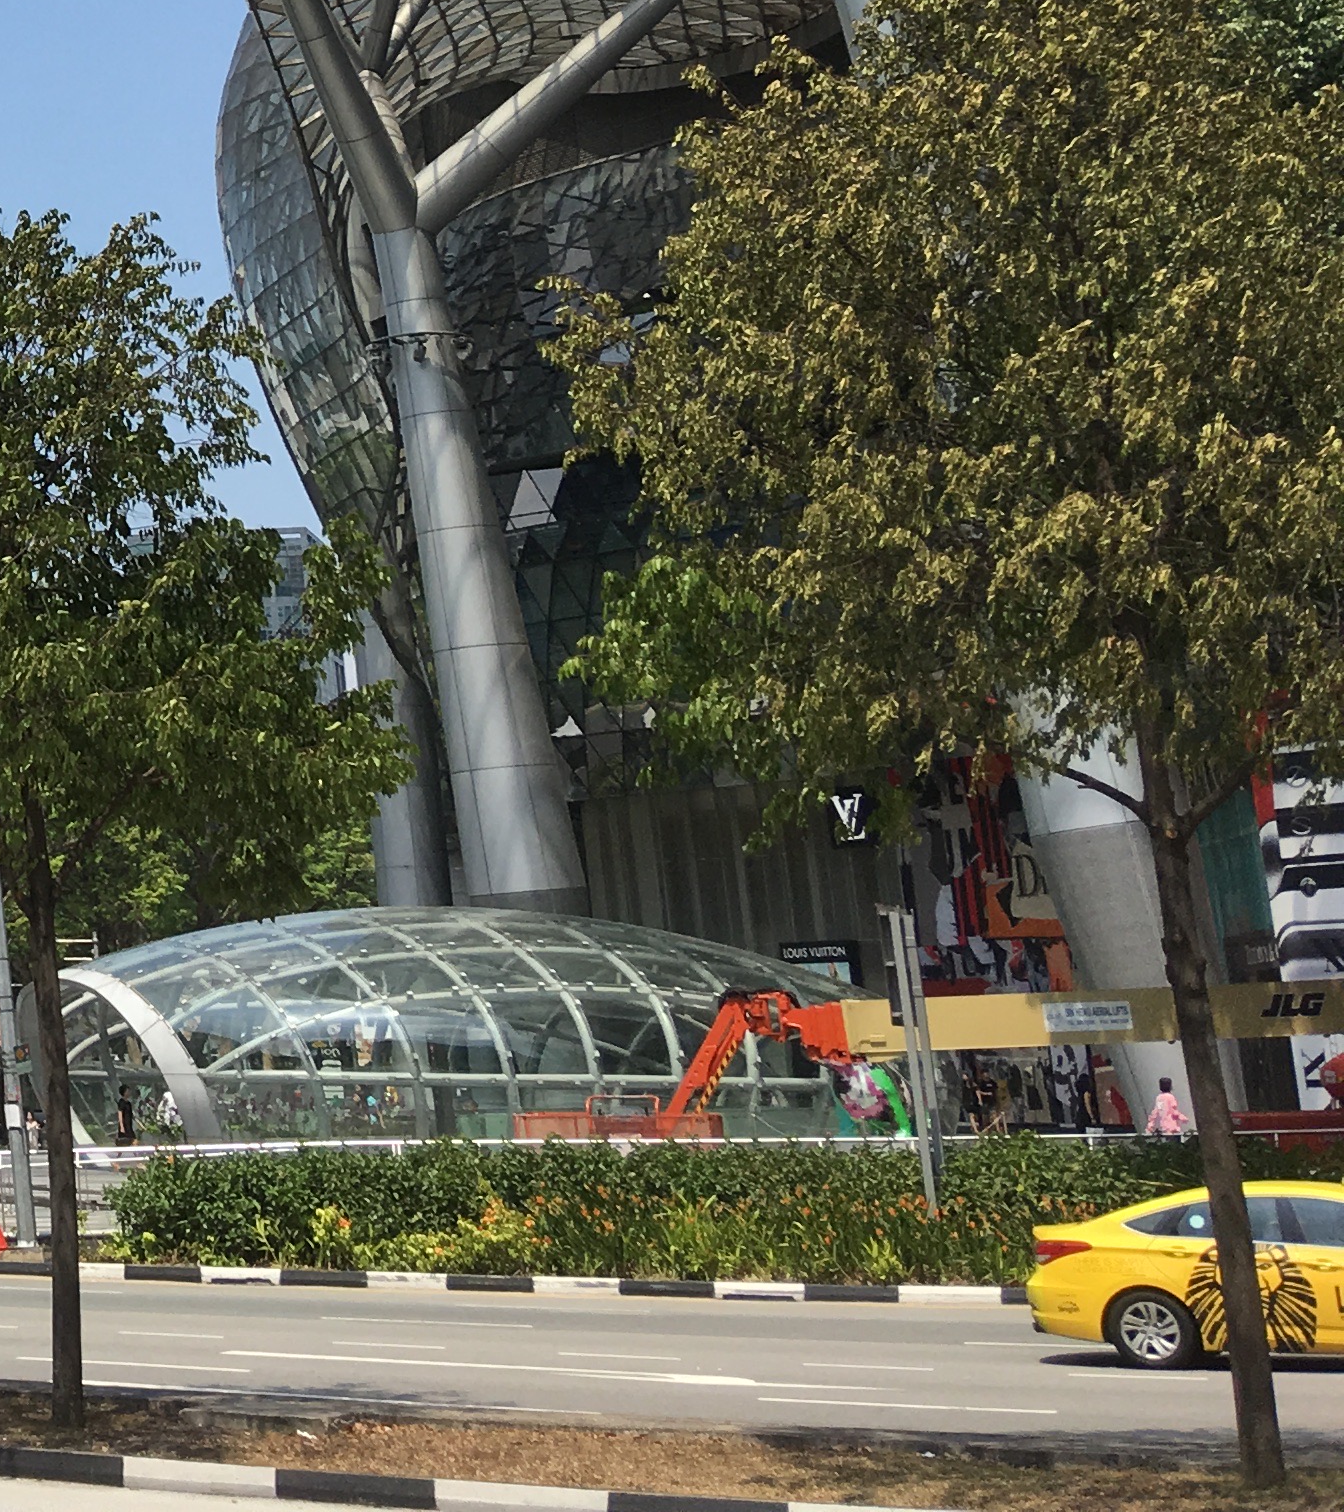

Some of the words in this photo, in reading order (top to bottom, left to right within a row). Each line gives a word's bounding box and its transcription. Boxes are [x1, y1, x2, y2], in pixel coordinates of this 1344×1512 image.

[783, 949, 808, 959] LOUIS
[809, 946, 846, 957] VUITTON
[1261, 993, 1324, 1017] JLG
